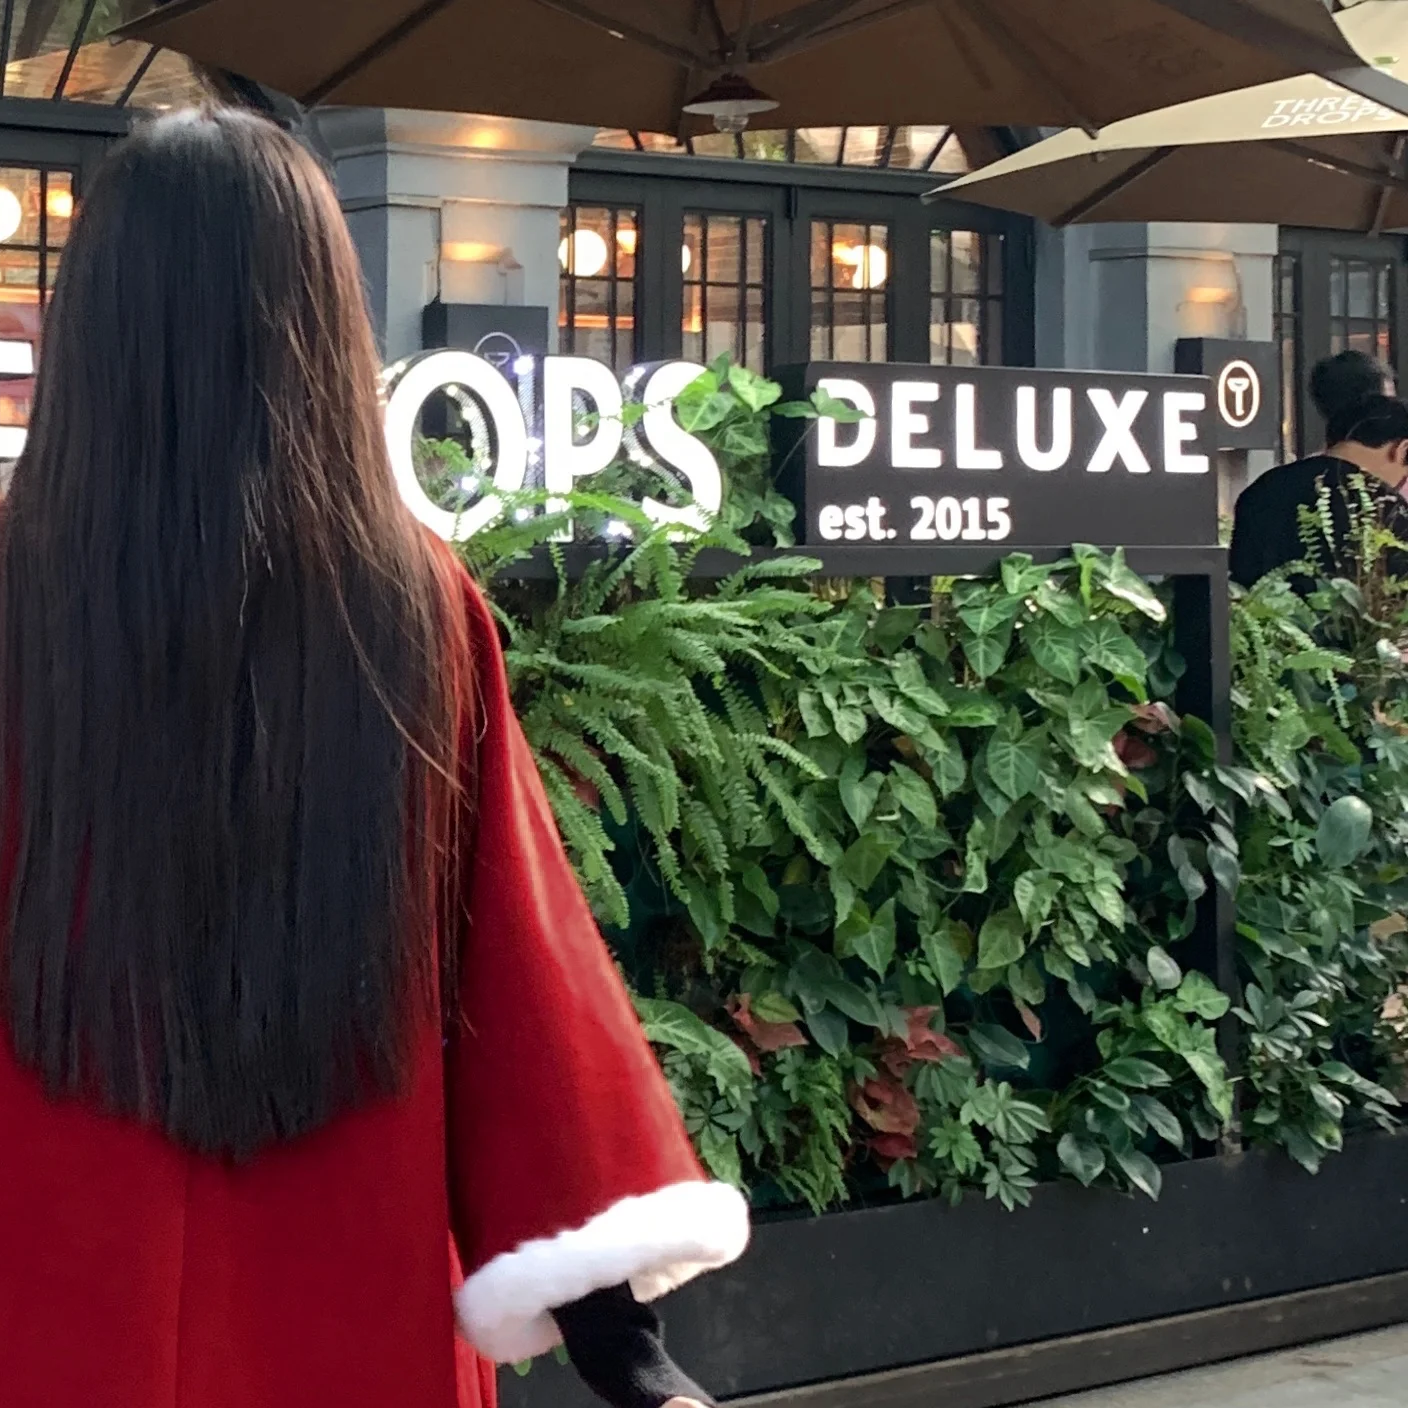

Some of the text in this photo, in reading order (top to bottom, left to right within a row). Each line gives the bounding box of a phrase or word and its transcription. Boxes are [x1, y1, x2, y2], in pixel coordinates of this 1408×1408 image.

[1260, 107, 1396, 128] DROPS
[816, 377, 1210, 474] DELUXE
[817, 495, 1012, 541] est. 2015
